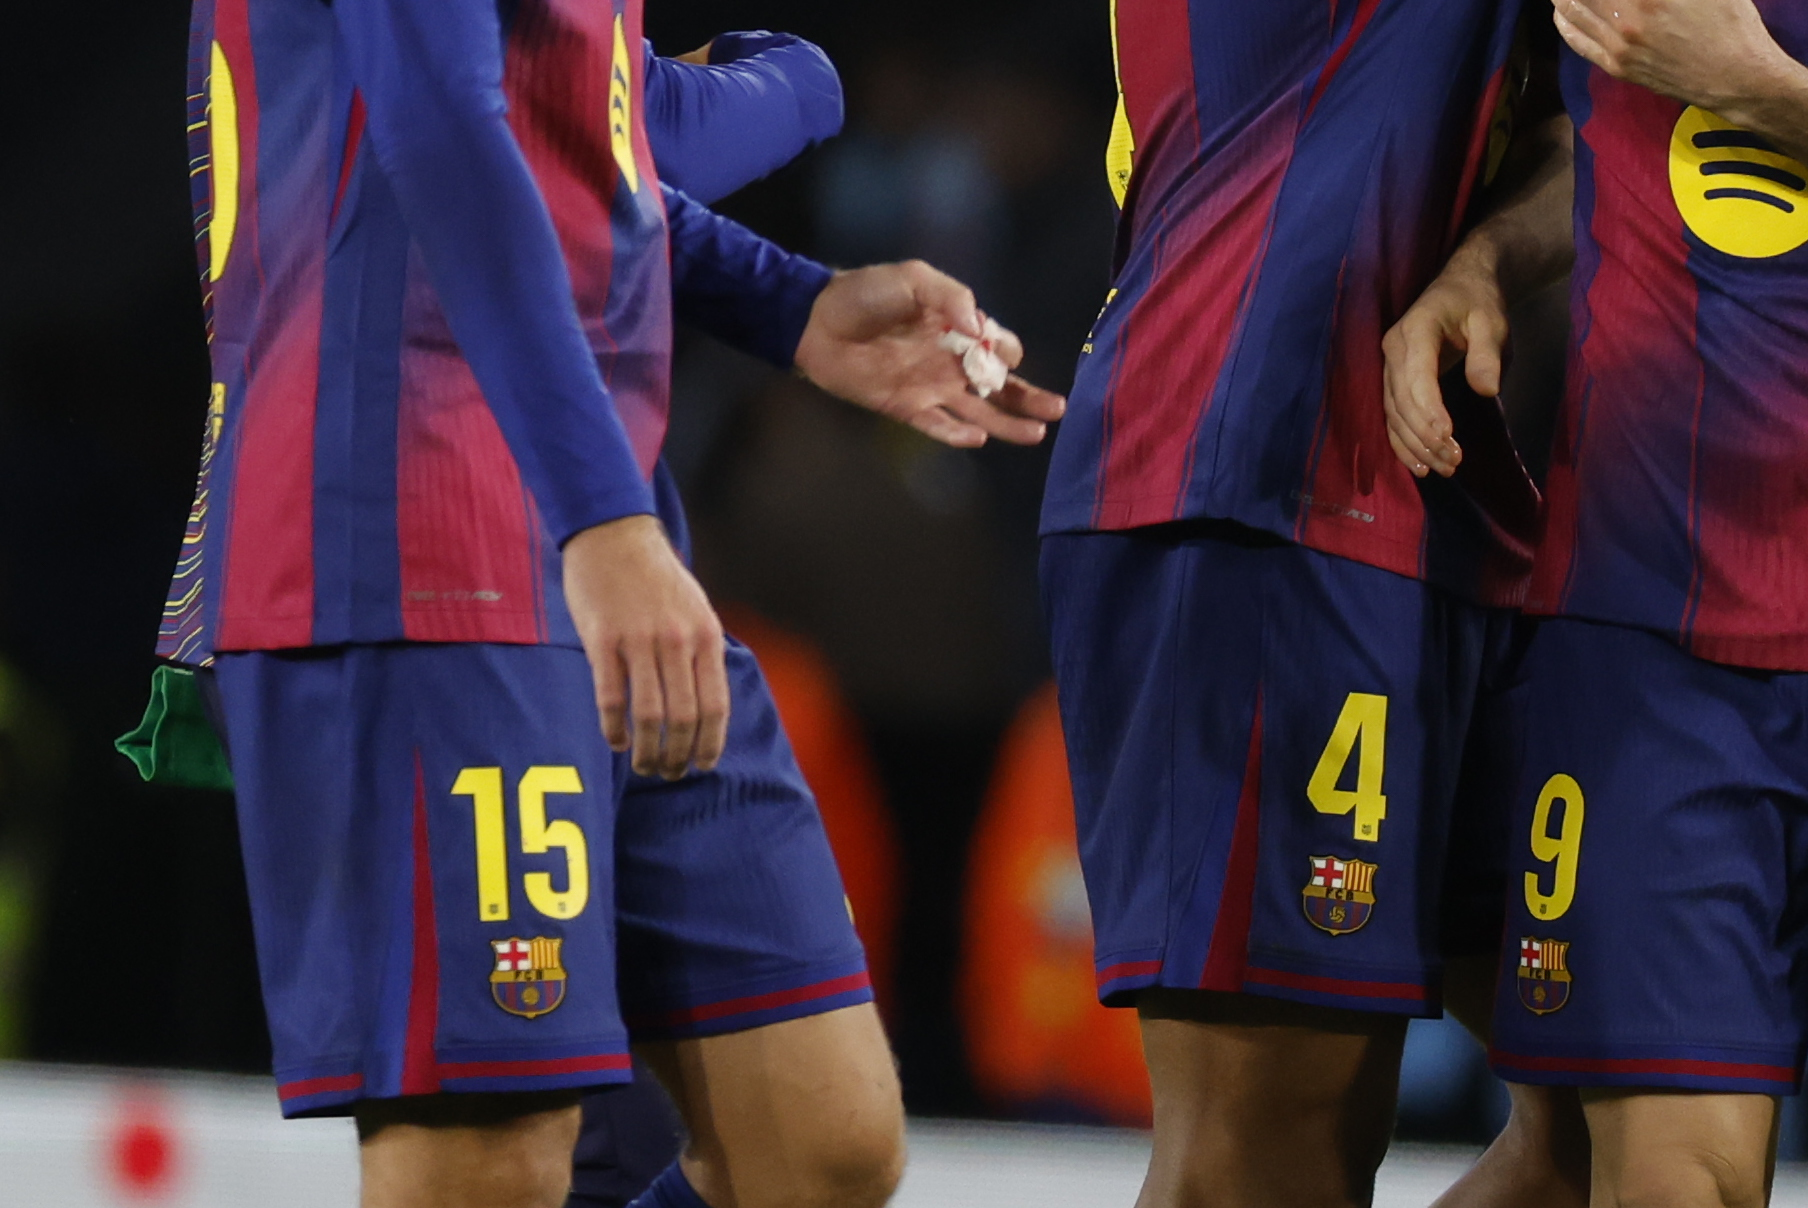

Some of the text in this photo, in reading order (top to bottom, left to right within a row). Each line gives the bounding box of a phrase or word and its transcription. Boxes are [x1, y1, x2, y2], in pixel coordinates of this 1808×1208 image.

[1305, 691, 1389, 842] 4
[448, 764, 590, 922] 15
[1522, 772, 1586, 922] 9
